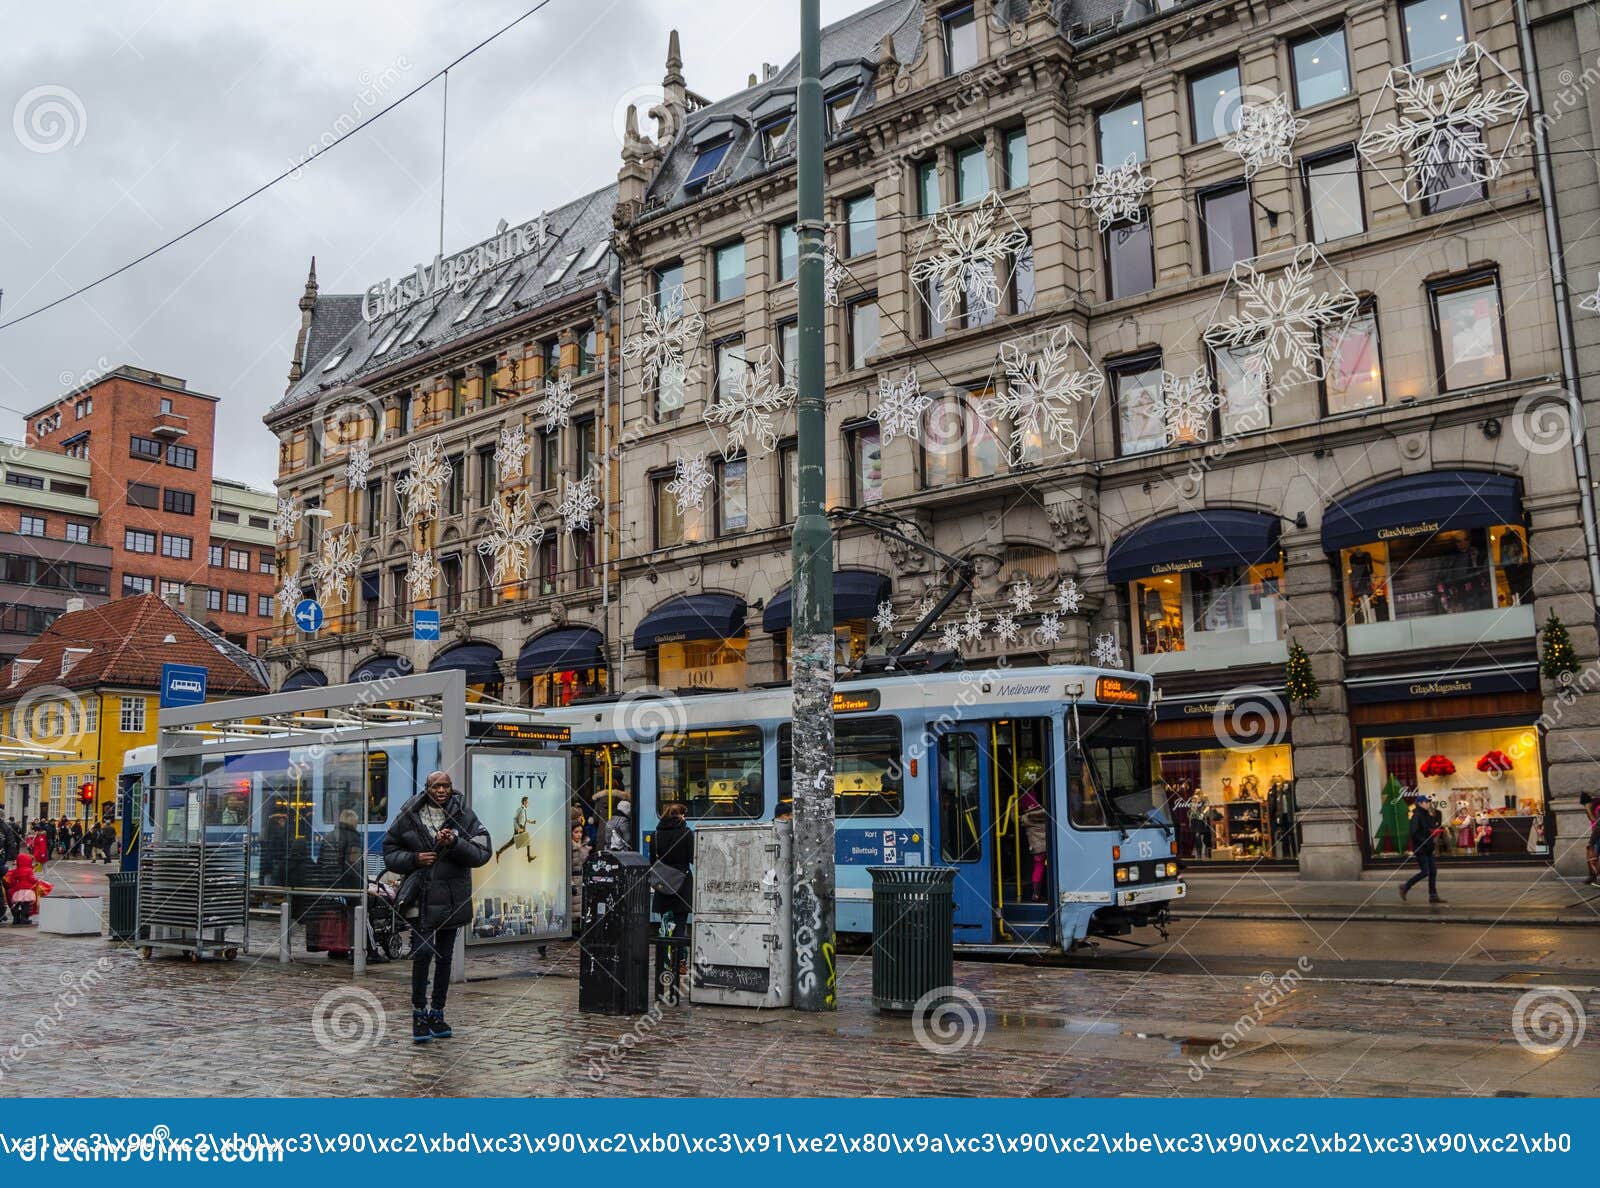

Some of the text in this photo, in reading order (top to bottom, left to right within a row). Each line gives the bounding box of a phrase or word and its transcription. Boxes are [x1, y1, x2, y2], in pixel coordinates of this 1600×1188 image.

[361, 210, 550, 322] GlasMagasinet
[1377, 522, 1440, 539] GlasMagasinet
[1151, 560, 1203, 574] GlasMagasinet
[1397, 590, 1435, 602] KRISS
[996, 684, 1051, 697] Melbourne
[1409, 680, 1472, 695] GlasMagasinet
[1183, 702, 1235, 714] GlasMagasinet
[493, 774, 547, 789] MITTY
